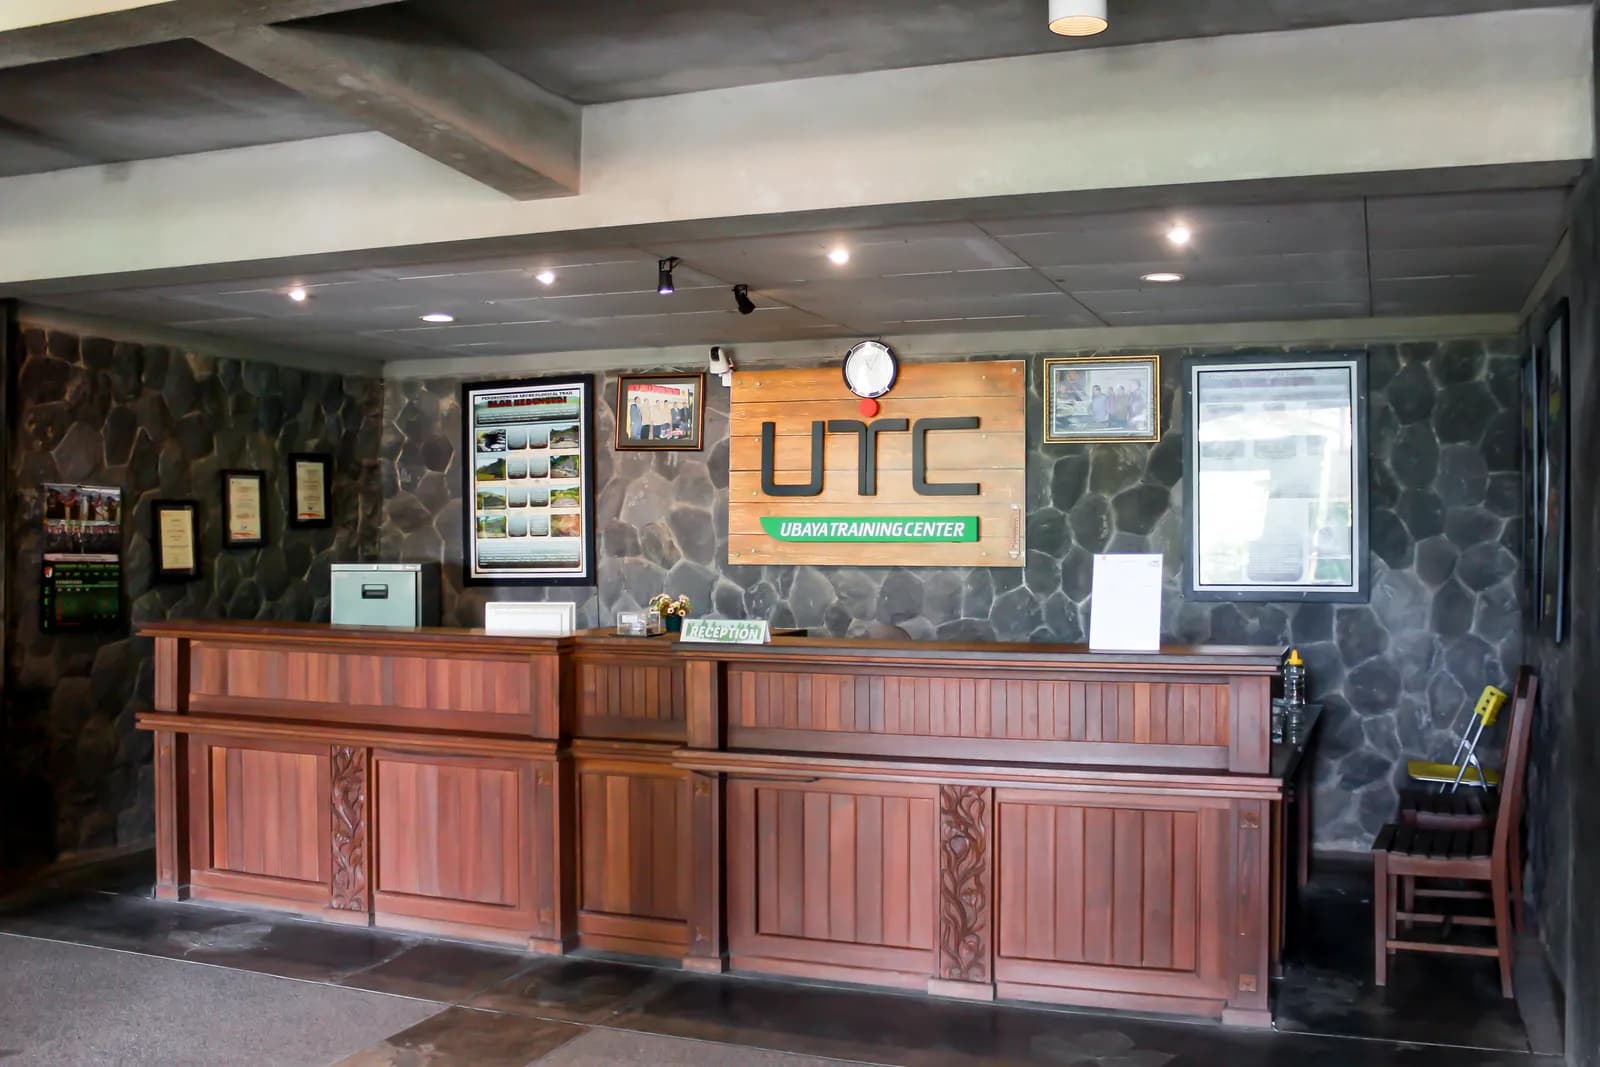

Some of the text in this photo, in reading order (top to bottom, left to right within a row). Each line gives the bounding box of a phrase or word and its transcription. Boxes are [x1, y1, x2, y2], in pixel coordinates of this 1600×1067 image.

[761, 416, 980, 496] UTC
[780, 521, 966, 537] UBAYA TRAINING CENTER
[690, 625, 759, 641] RECEPTION
